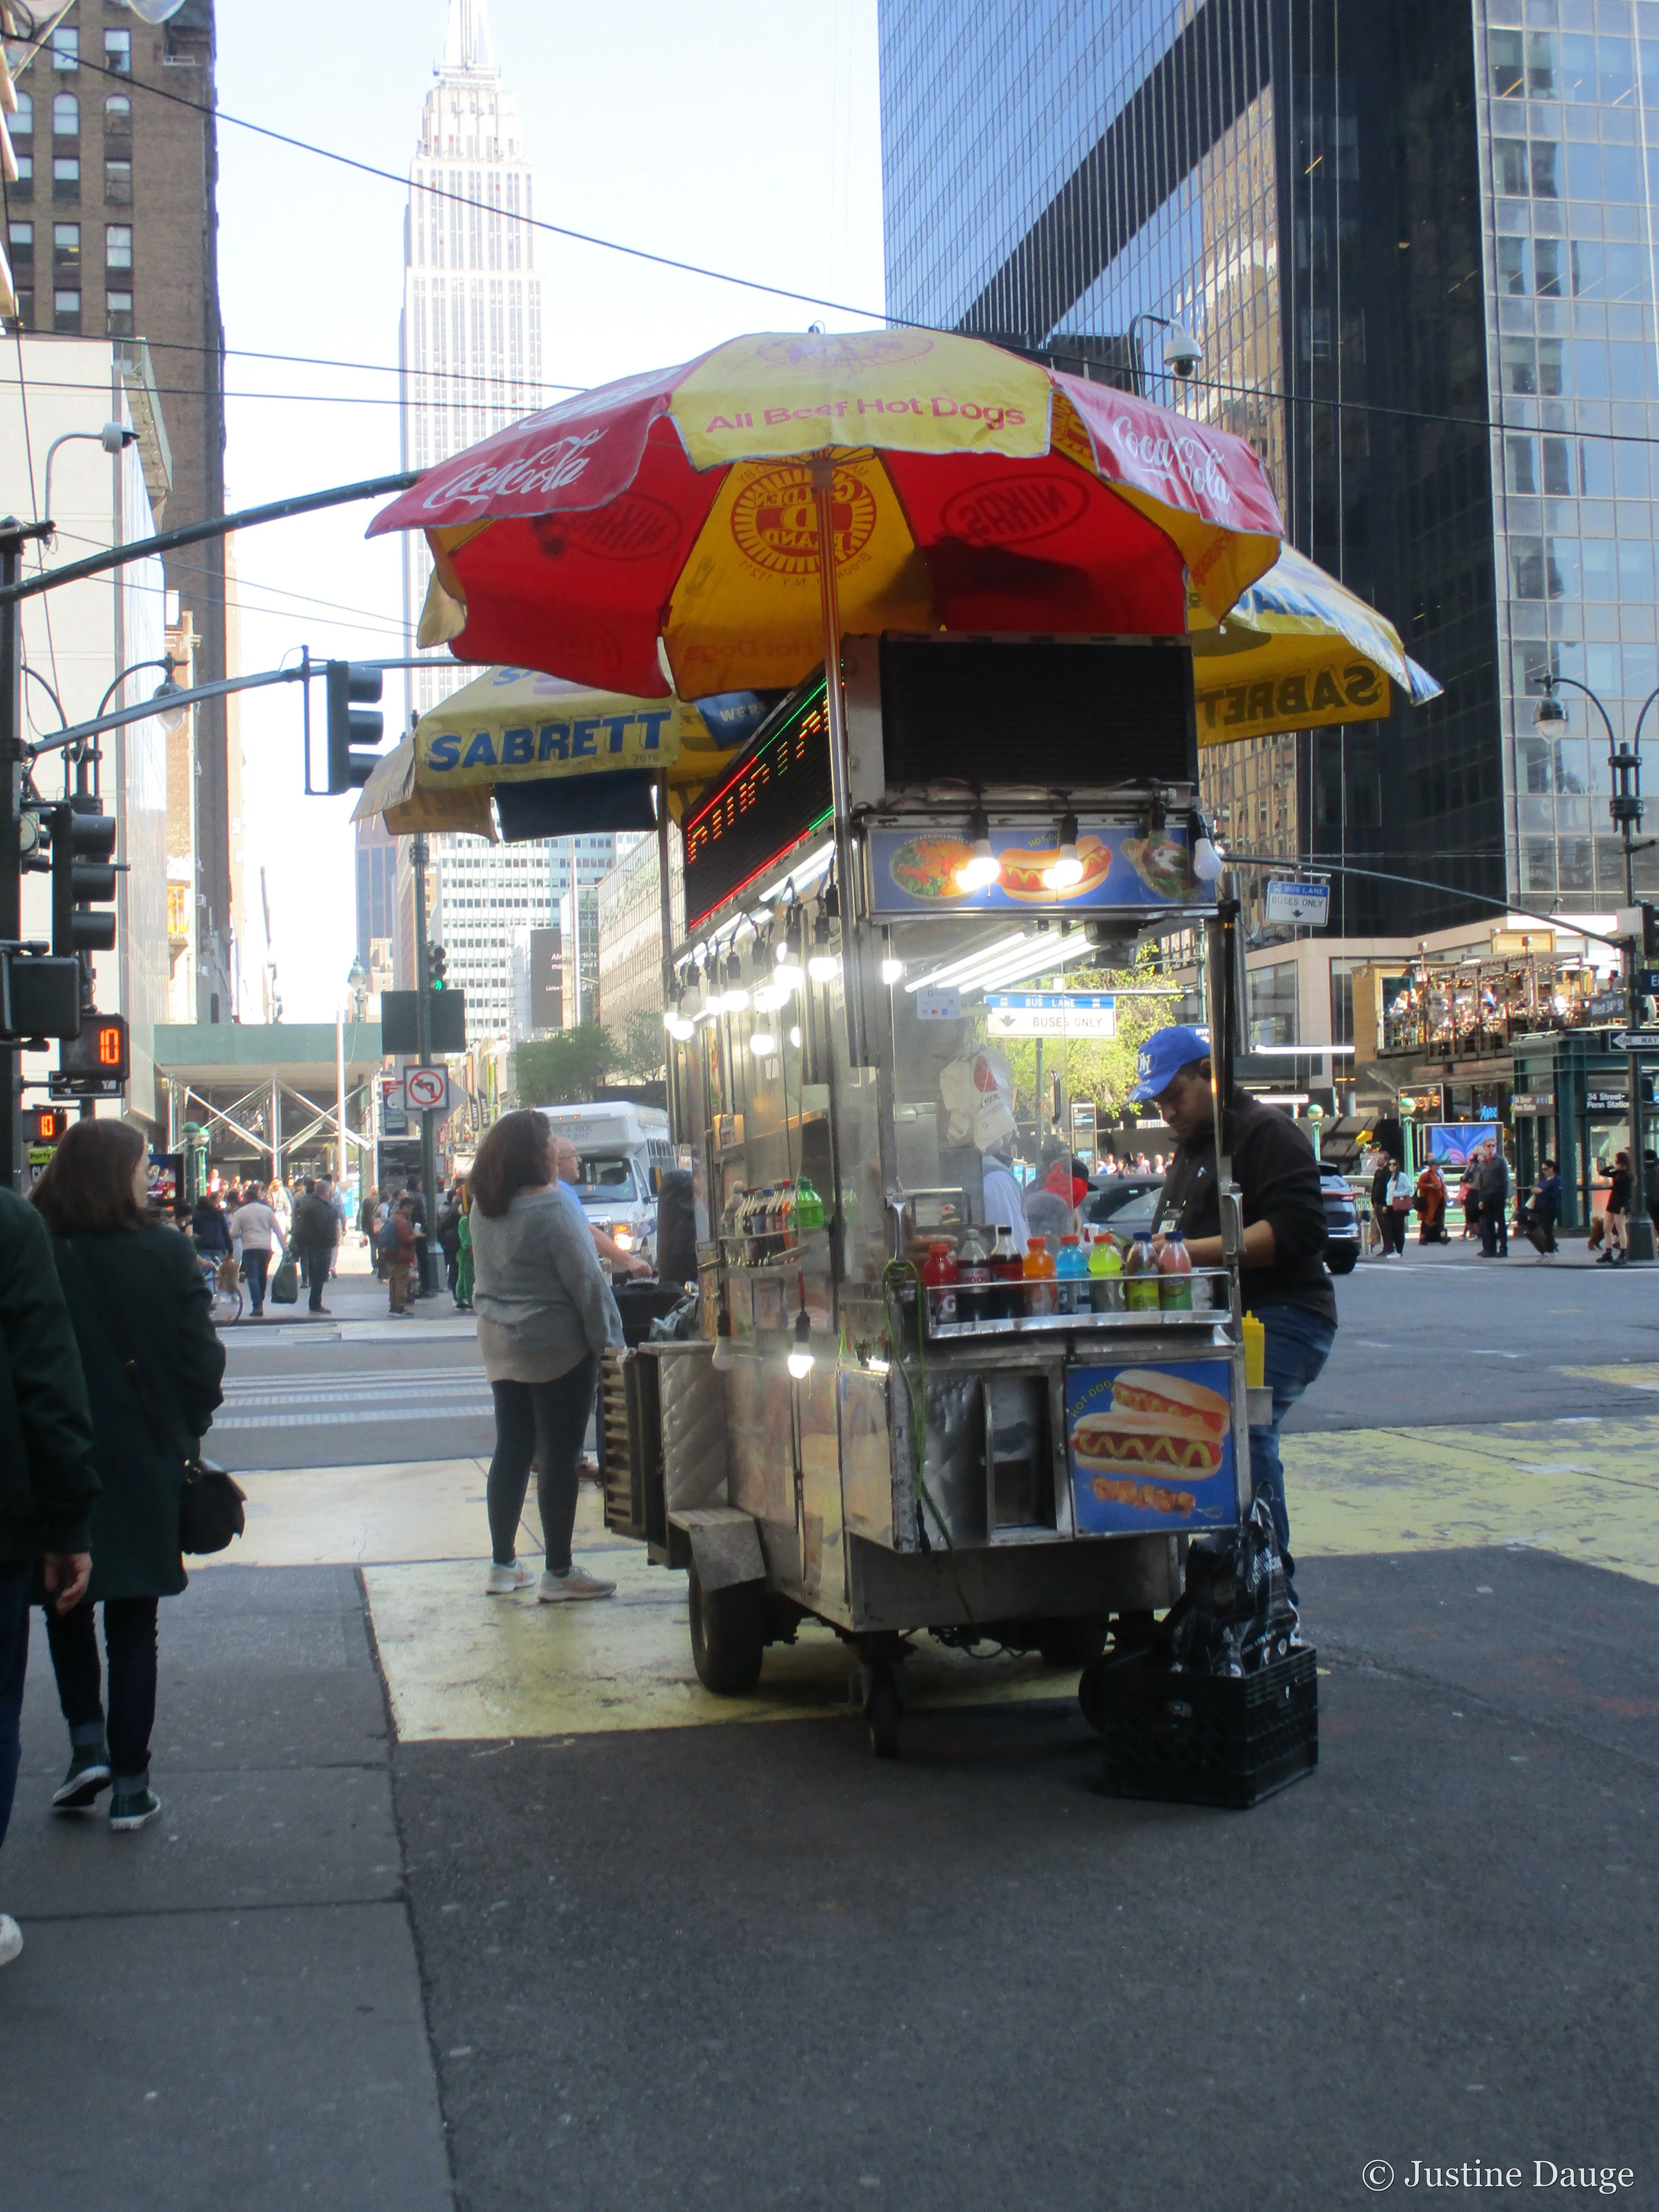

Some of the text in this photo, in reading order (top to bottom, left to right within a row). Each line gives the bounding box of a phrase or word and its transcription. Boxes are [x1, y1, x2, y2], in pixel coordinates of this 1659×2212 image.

[706, 397, 1026, 433] All Beef Hot Dogs
[426, 708, 672, 771] SABRETT
[633, 754, 659, 764] 2018
[1272, 896, 1323, 908] BUSES ONLY
[1025, 998, 1076, 1008] BUS LANE
[1033, 1017, 1102, 1027] BUSES ONLY
[1619, 1036, 1633, 1044] ONE
[100, 1027, 120, 1065] 10
